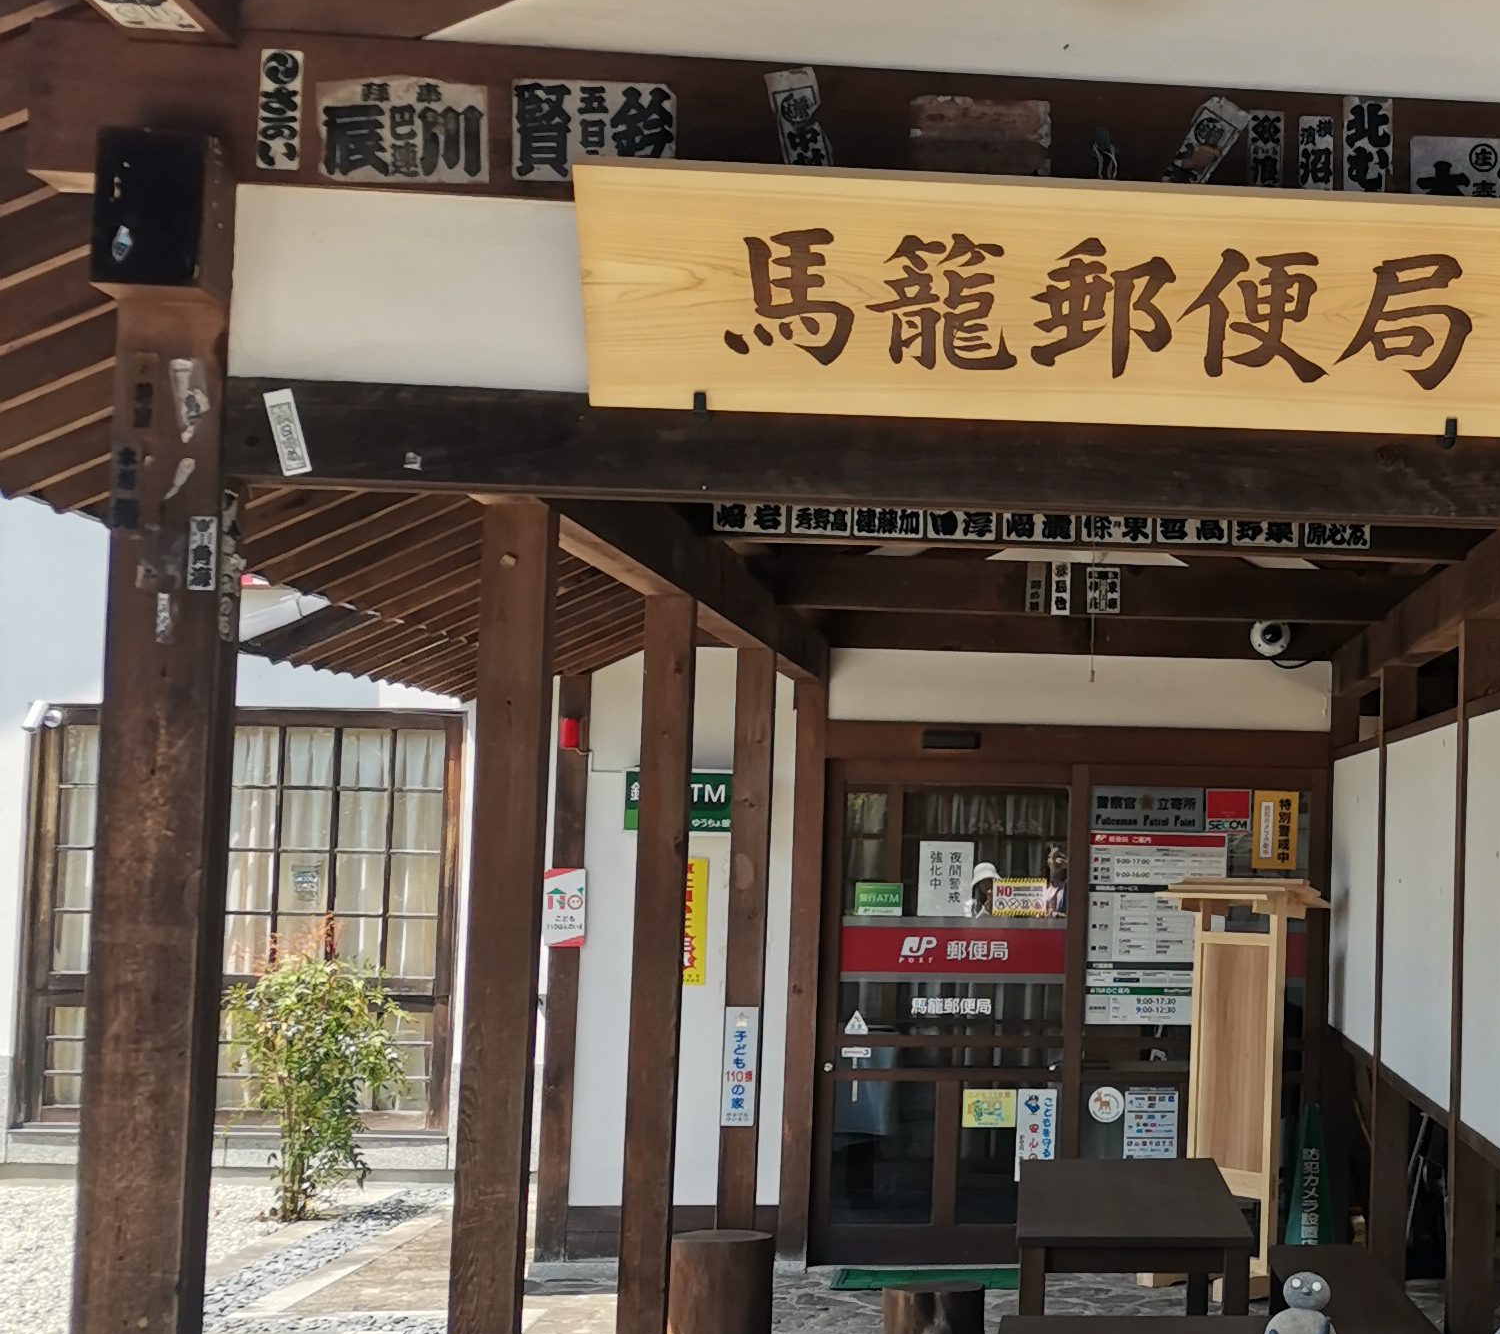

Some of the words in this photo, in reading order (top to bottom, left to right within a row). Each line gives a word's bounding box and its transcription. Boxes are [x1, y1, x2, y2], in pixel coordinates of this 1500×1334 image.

[724, 227, 1473, 391] 馬籠郵便局
[1208, 819, 1248, 830] SECOM
[995, 885, 1013, 898] NO
[946, 940, 1009, 962] 郵便局
